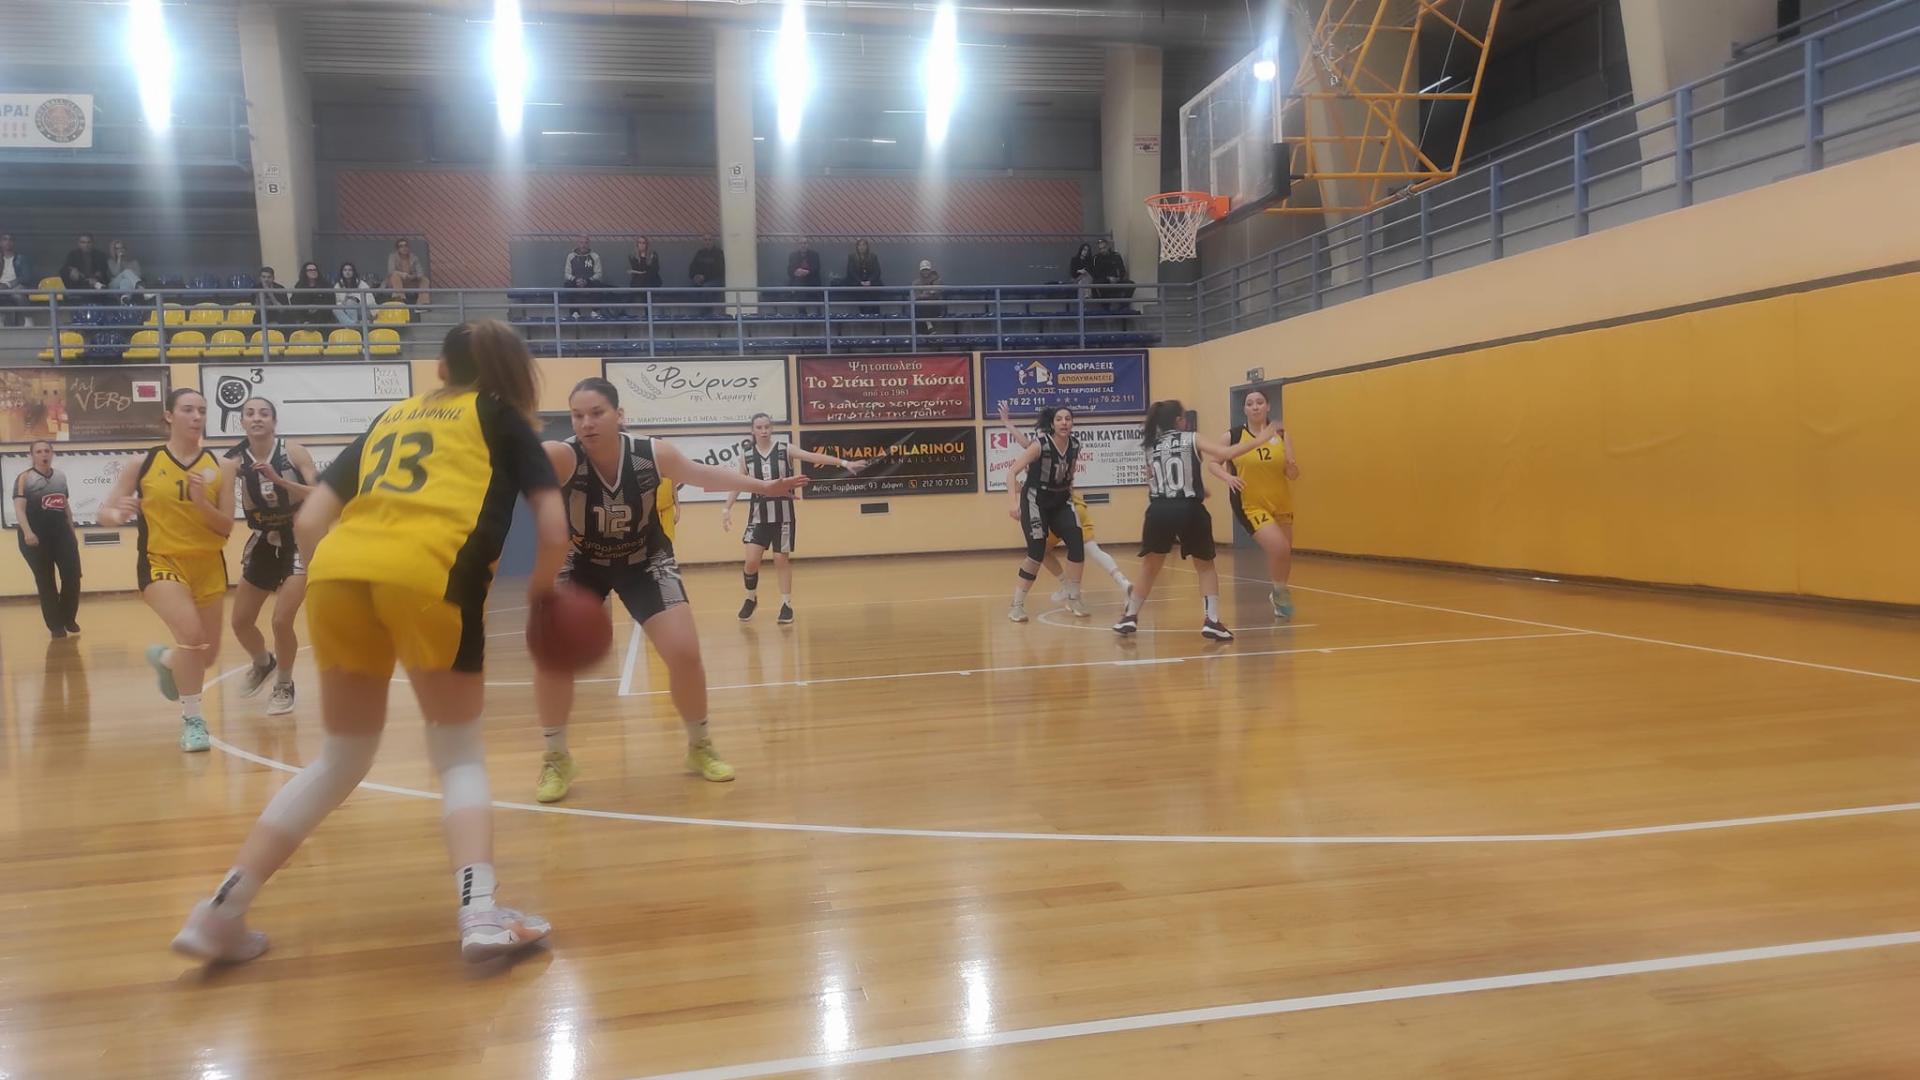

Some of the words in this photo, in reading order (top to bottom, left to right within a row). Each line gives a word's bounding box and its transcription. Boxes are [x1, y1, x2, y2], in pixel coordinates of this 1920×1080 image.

[0, 104, 29, 117] ΡΑ!
[848, 361, 923, 374] Ψητοπωλείο
[1057, 362, 1114, 371] ΑΠΟΦΡΑΞΕΙΣ
[655, 366, 760, 400] Φούρνος
[805, 376, 827, 389] Το
[831, 375, 875, 388] Στέκι
[880, 377, 907, 387] του
[912, 373, 965, 386] Κώστα
[75, 391, 132, 412] VERO
[810, 401, 825, 410] Το
[829, 399, 885, 411] καλύτερο
[1021, 397, 1031, 406] 22
[842, 445, 887, 459] MARIA
[889, 442, 965, 456] PILARINOU
[1256, 447, 1272, 461] 12
[360, 430, 434, 498] 13
[82, 476, 112, 485] coffee
[922, 480, 934, 488] 212
[935, 479, 943, 487] 10
[945, 479, 954, 487] 72
[955, 478, 968, 486] 033
[175, 479, 194, 501] 1
[593, 504, 632, 533] 12
[1254, 512, 1269, 525] 12
